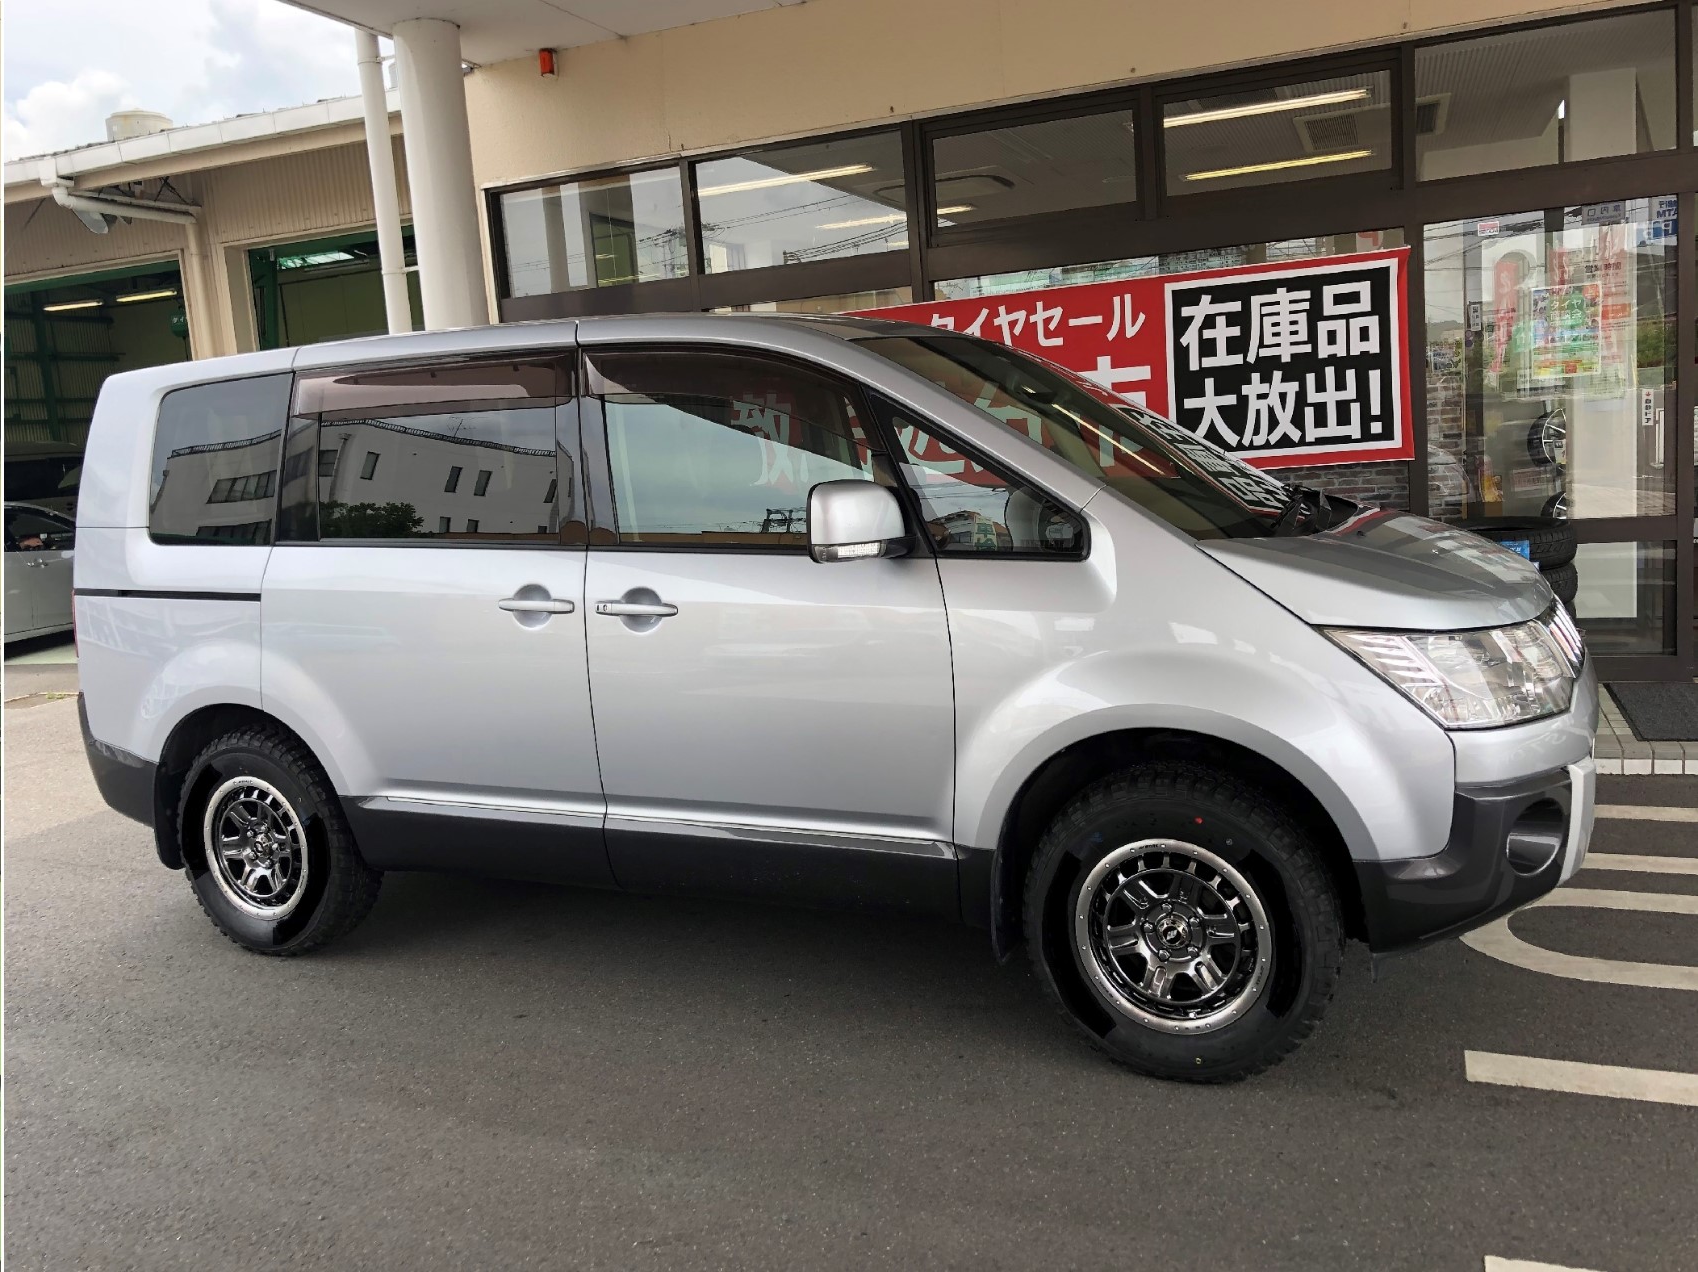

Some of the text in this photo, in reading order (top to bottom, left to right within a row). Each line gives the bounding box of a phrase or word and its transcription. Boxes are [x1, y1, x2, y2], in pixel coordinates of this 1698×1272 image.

[1179, 280, 1380, 372] 在庫品
[1182, 366, 1383, 448] 大放出!
